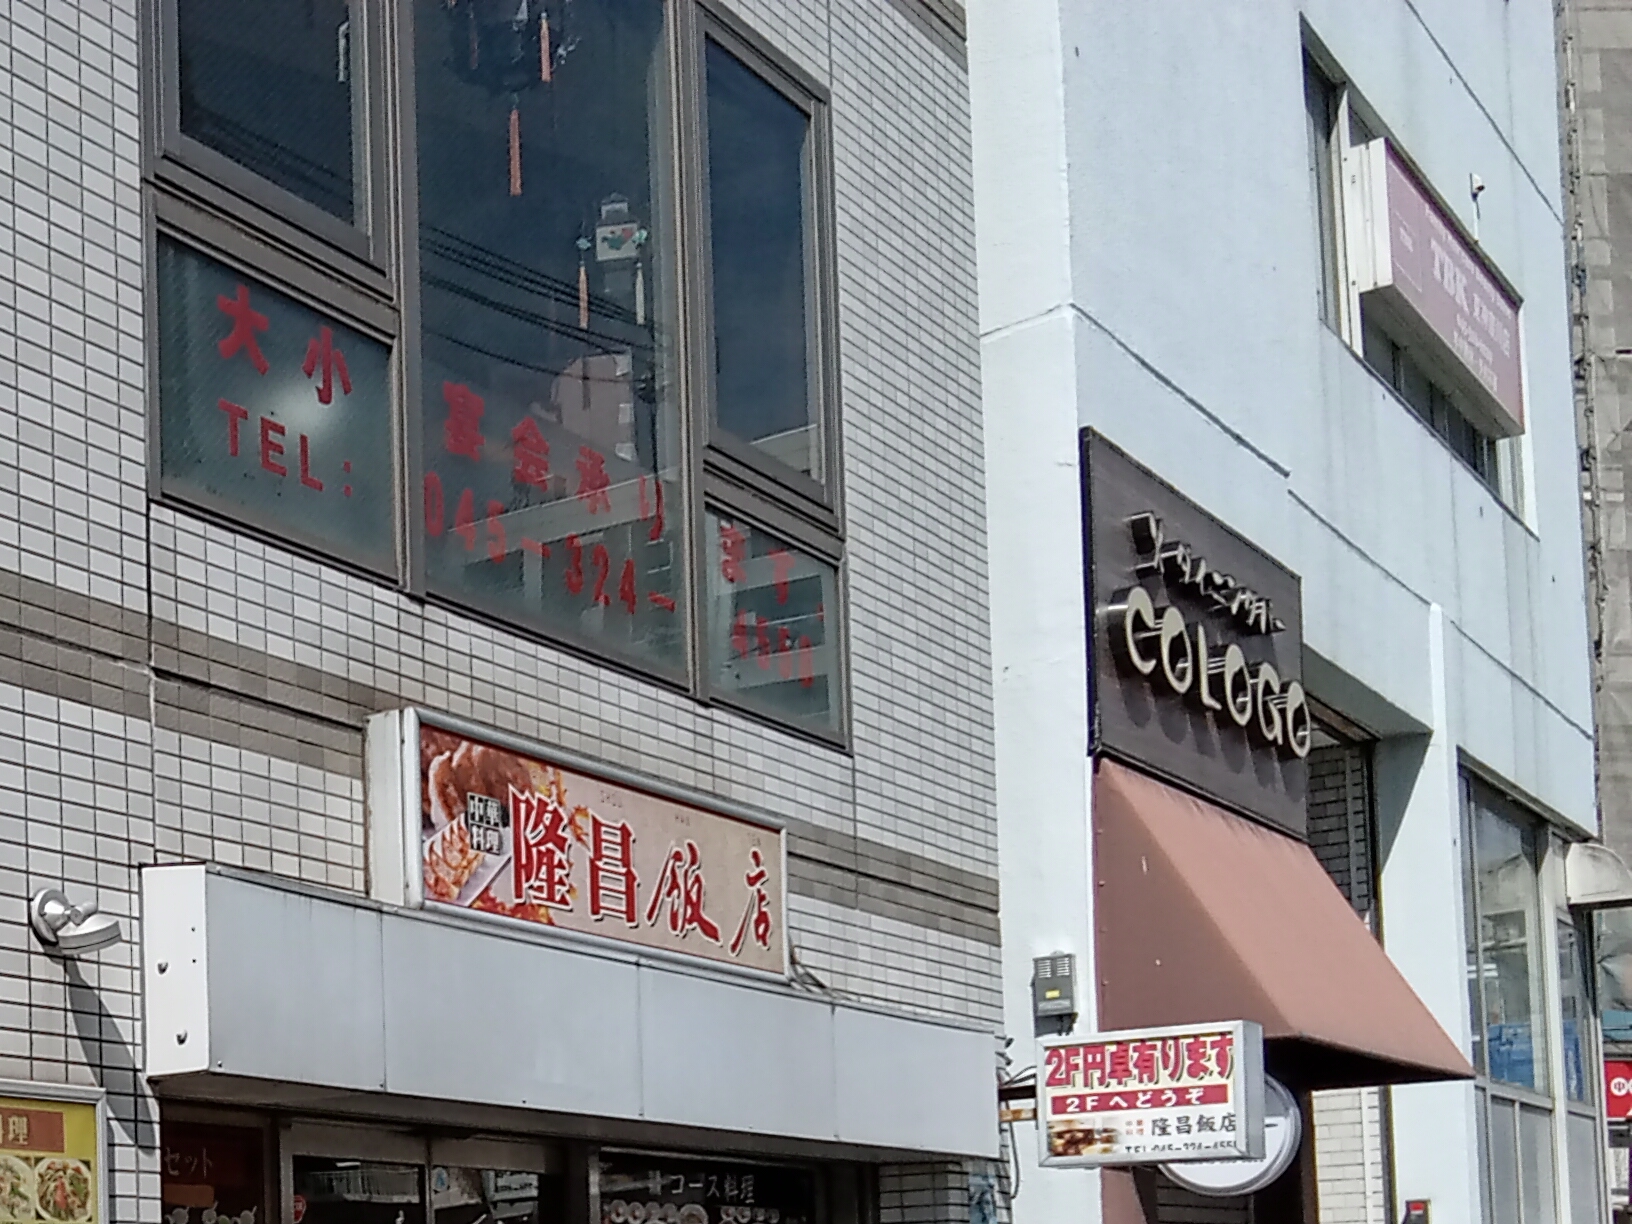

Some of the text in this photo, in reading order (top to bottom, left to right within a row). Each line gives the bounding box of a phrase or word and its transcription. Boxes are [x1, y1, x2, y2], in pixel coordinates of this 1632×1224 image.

[1125, 586, 1310, 757] COLOGO
[508, 783, 771, 957] 隆昌飯店
[1045, 1032, 1234, 1087] 2F円卓有ります
[1066, 1088, 1204, 1112] 2Fへどうぞ
[1151, 1113, 1236, 1137] 隆昌飯店
